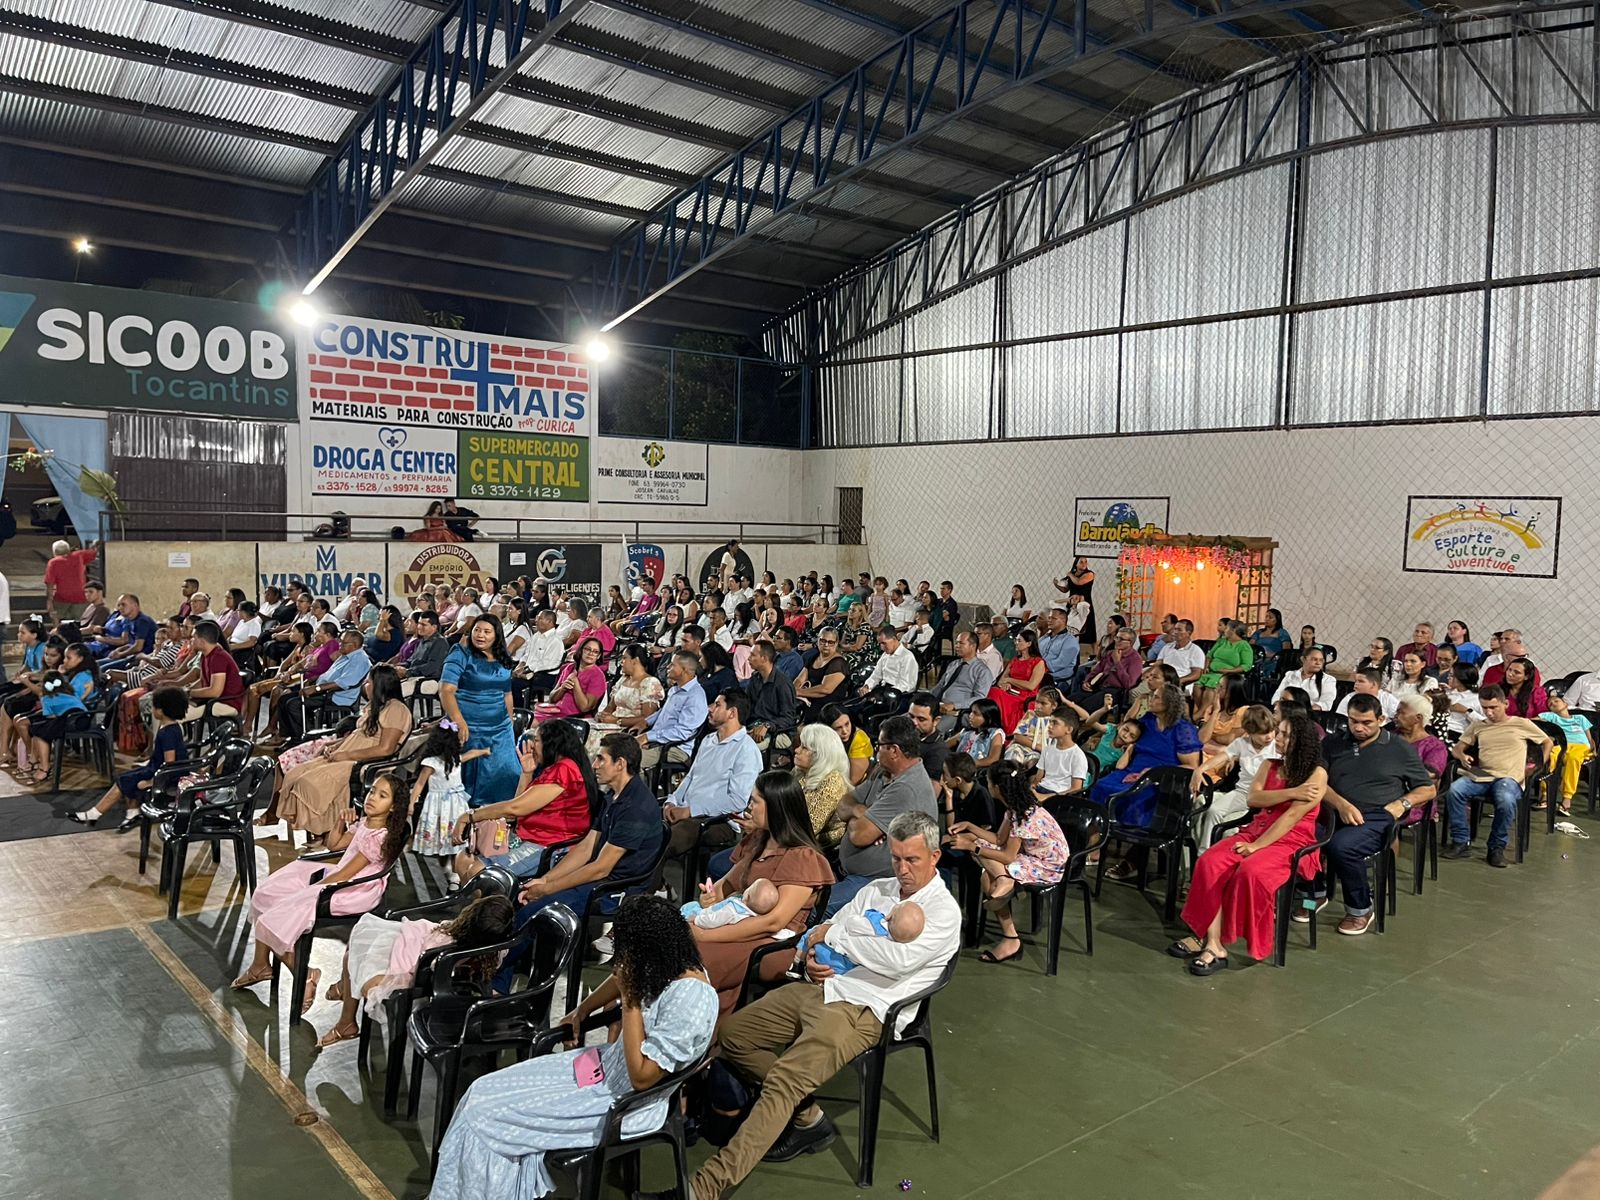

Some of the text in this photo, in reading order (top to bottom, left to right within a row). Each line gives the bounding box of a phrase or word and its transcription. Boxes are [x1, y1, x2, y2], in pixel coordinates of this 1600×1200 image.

[37, 308, 289, 380] SICOOB
[313, 320, 475, 368] CONSTRU
[125, 368, 289, 407] Tocantins
[493, 385, 586, 420] MAIS
[312, 401, 513, 429] MATERIAIS PARA CONSTRUÇÃO
[536, 419, 575, 433] CURICA
[469, 437, 579, 458] SUPERMERCADO
[313, 445, 456, 474] DROGA CENTER
[318, 470, 390, 480] MEDICAMENTOS
[402, 474, 452, 482] PERFUMARIA
[470, 458, 580, 487] CENTRAL
[471, 484, 485, 496] 63
[1435, 532, 1492, 551] Esporte
[416, 545, 473, 565] DISTRIBUIDORA
[1446, 544, 1520, 562] Cultura e
[429, 562, 464, 572] EMPÓRIO
[1448, 556, 1515, 573] Juventude
[260, 572, 383, 596] VIRAMR
